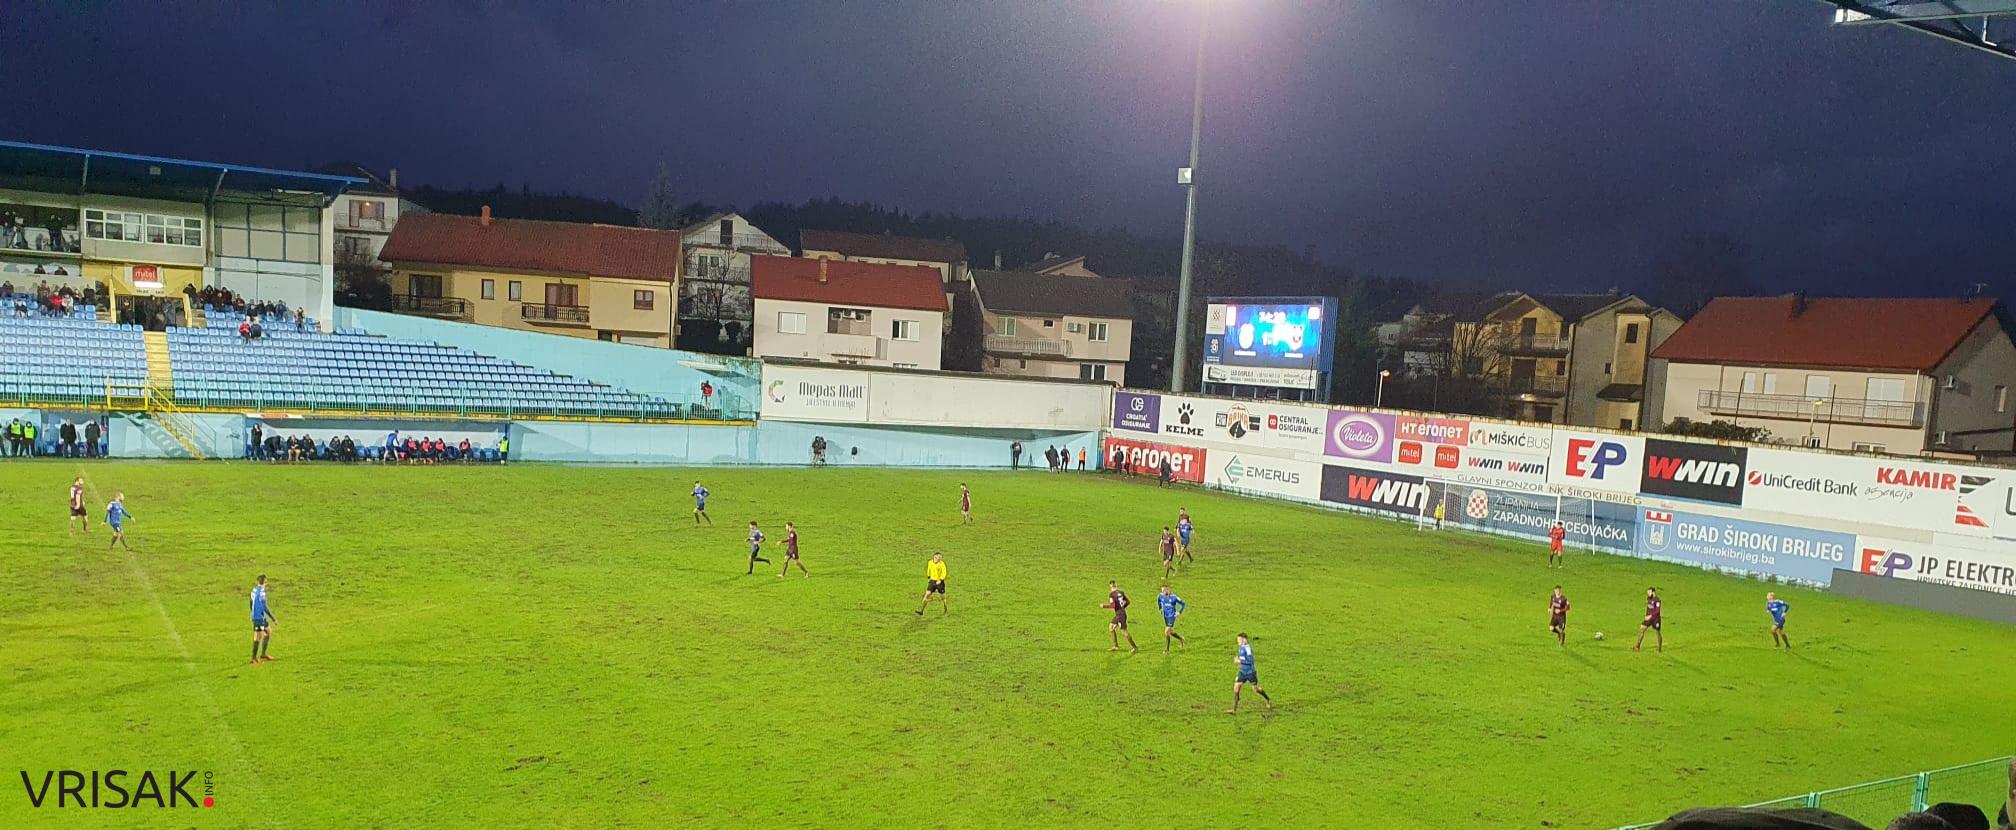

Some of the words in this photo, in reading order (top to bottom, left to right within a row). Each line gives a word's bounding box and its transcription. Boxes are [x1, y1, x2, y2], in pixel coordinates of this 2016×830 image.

[1166, 424, 1204, 437] KELME
[1278, 423, 1319, 435] OSIGURANJE
[1279, 415, 1309, 425] CENTRAL
[1401, 422, 1416, 434] HT
[1343, 422, 1376, 444] Violeta
[1488, 430, 1526, 447] MIŠKIĆ
[1526, 435, 1550, 450] BUS
[1565, 438, 1627, 480] EP
[1246, 466, 1300, 484] EMERUS
[1763, 472, 1820, 492] UniCredit
[1823, 478, 1858, 497] Bank
[1876, 466, 1957, 491] KAMIR
[1457, 473, 1492, 486] GLAVNI
[1495, 478, 1544, 492] SPONZOR
[1550, 485, 1564, 495] NK
[1567, 486, 1602, 500] ŠIROKI
[1606, 493, 1643, 506] BRIJEG
[1864, 485, 1914, 504] agencija
[1677, 522, 1719, 543] GRAD
[1723, 525, 1778, 552] ŠIROKI
[1782, 538, 1844, 562] BRIJEG
[1676, 541, 1775, 566] www.sirokibrijeg.ba
[1917, 555, 1939, 575] JP
[1945, 559, 2016, 587] ELEKTR
